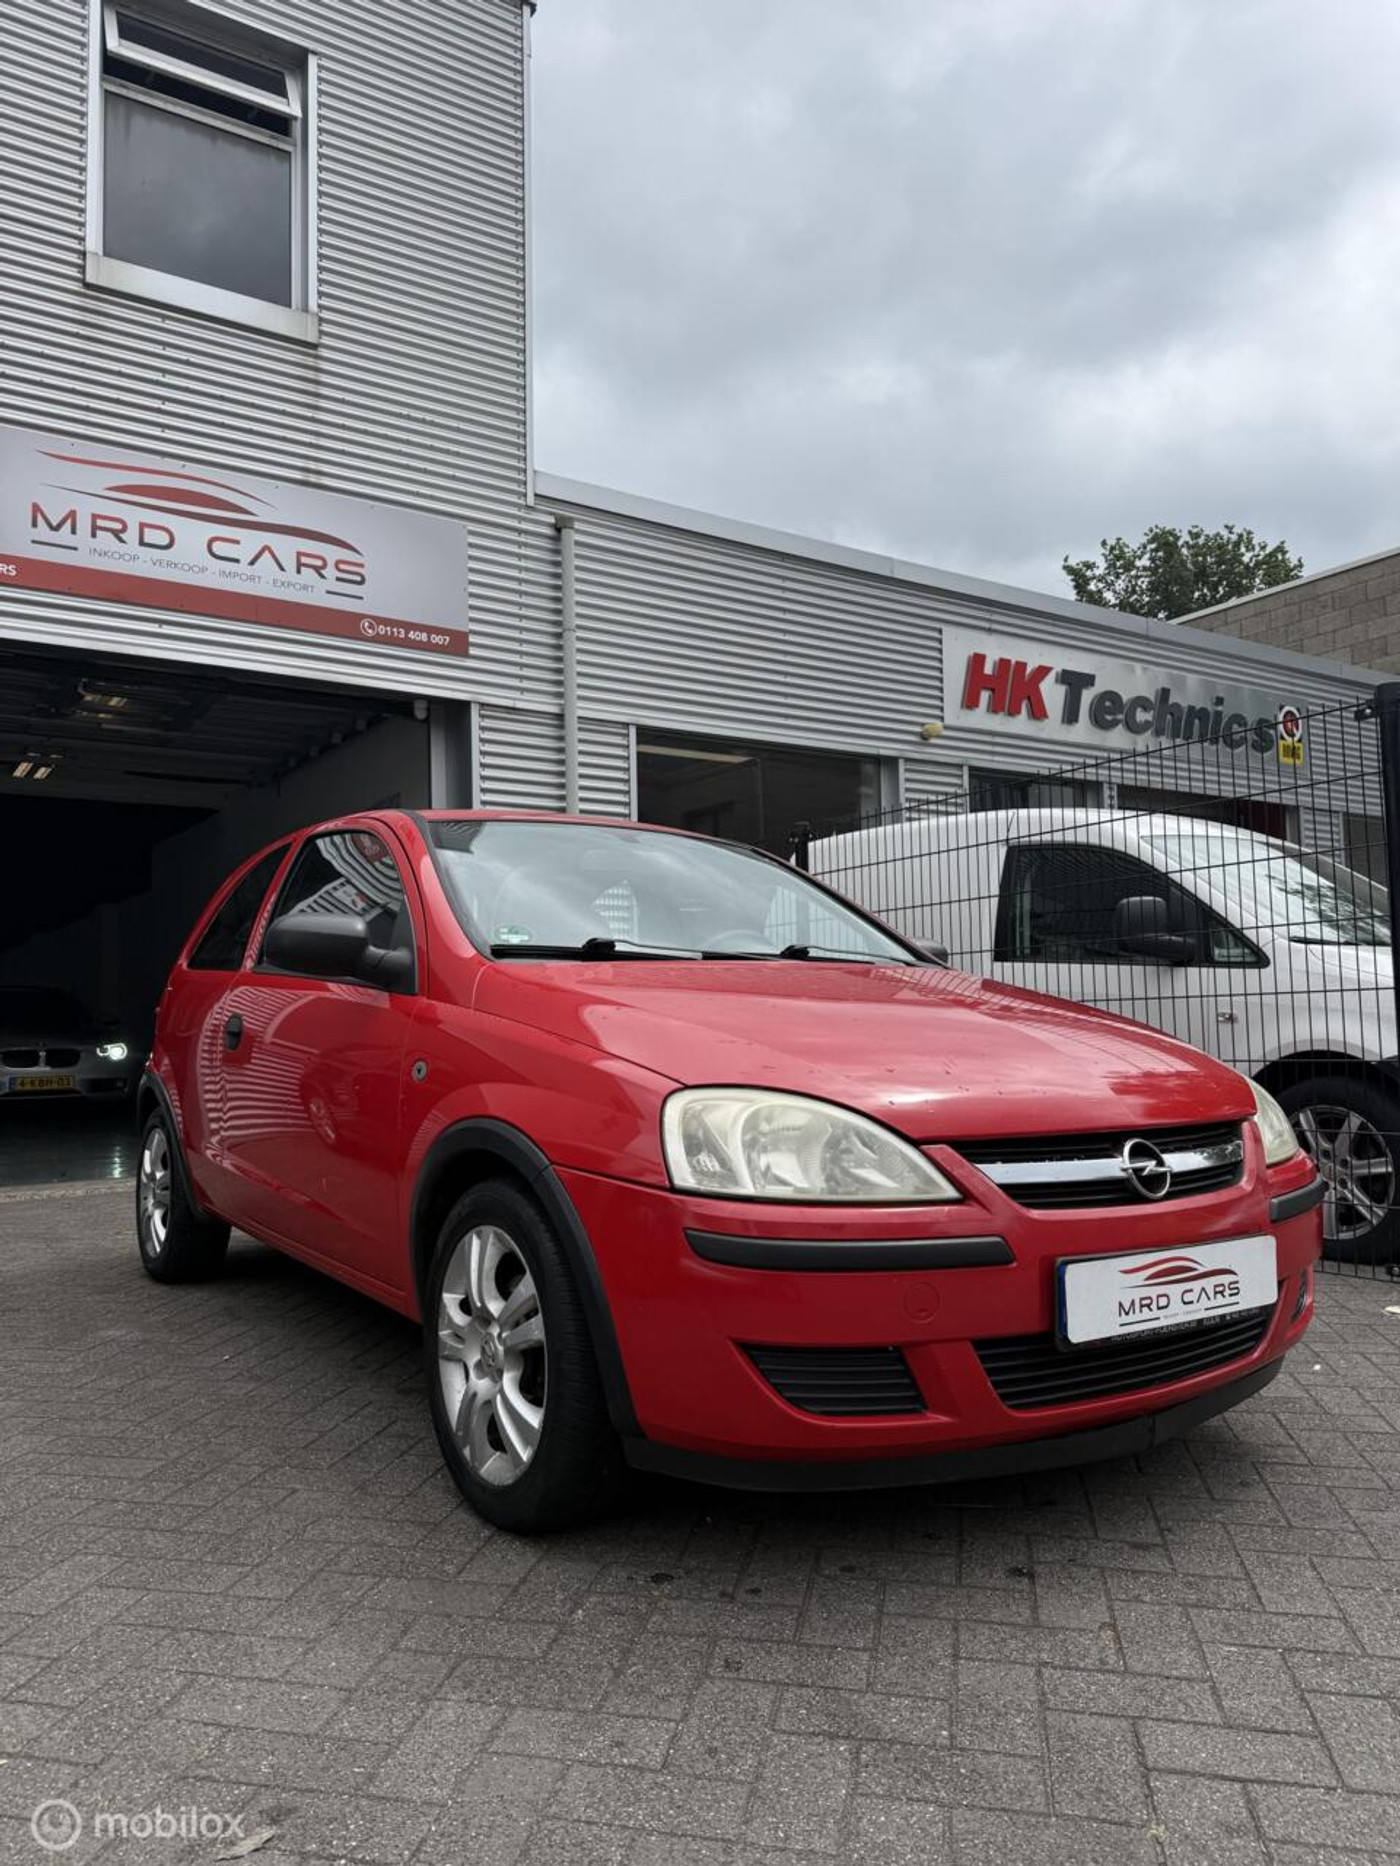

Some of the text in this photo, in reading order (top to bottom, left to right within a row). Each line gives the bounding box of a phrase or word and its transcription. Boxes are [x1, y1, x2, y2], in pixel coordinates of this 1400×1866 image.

[31, 502, 366, 586] MRD CARS
[89, 547, 140, 563] INKOOP
[150, 557, 209, 575] VERKOOP
[218, 569, 262, 585] IMPORT
[272, 577, 315, 594] EXPORT
[378, 625, 450, 645] 0113 408 007
[1118, 1293, 1171, 1317] MRD
[1181, 1280, 1240, 1305] CARS
